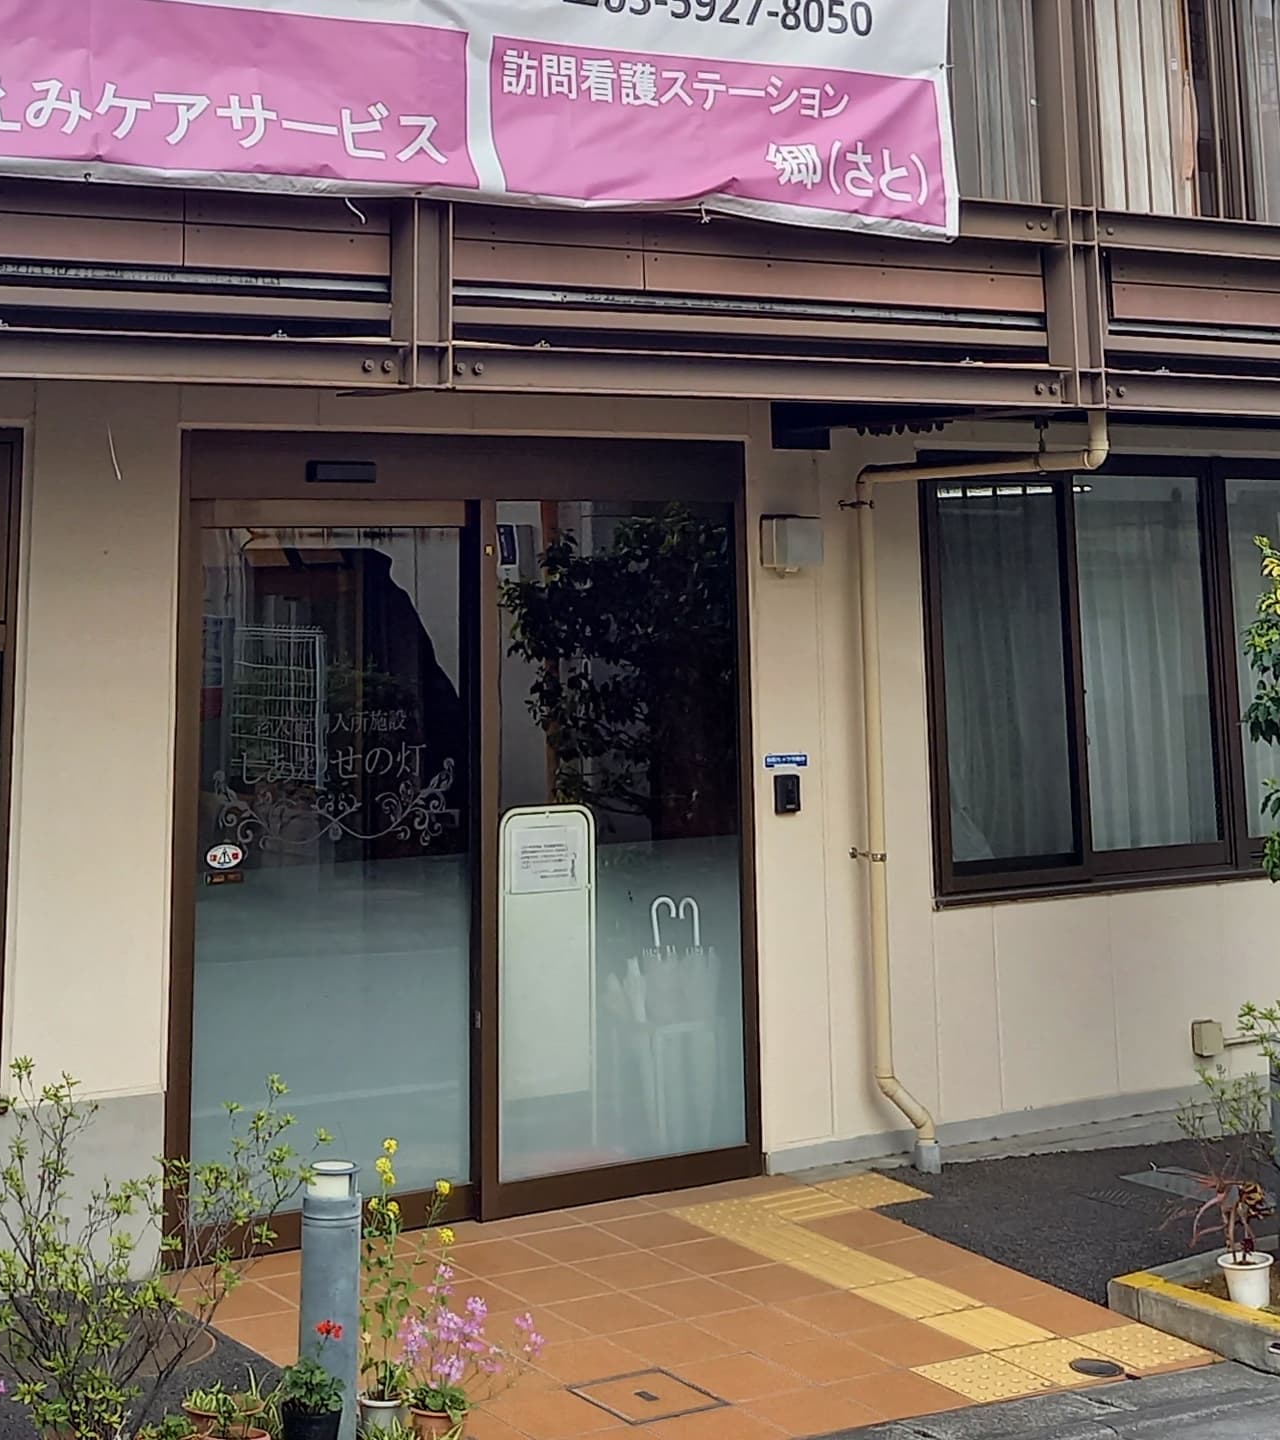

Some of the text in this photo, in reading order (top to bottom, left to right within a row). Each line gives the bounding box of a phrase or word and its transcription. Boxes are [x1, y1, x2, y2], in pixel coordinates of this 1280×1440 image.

[502, 49, 849, 119] 訪問看護ステーション
[241, 741, 427, 784] しあわせの灯
